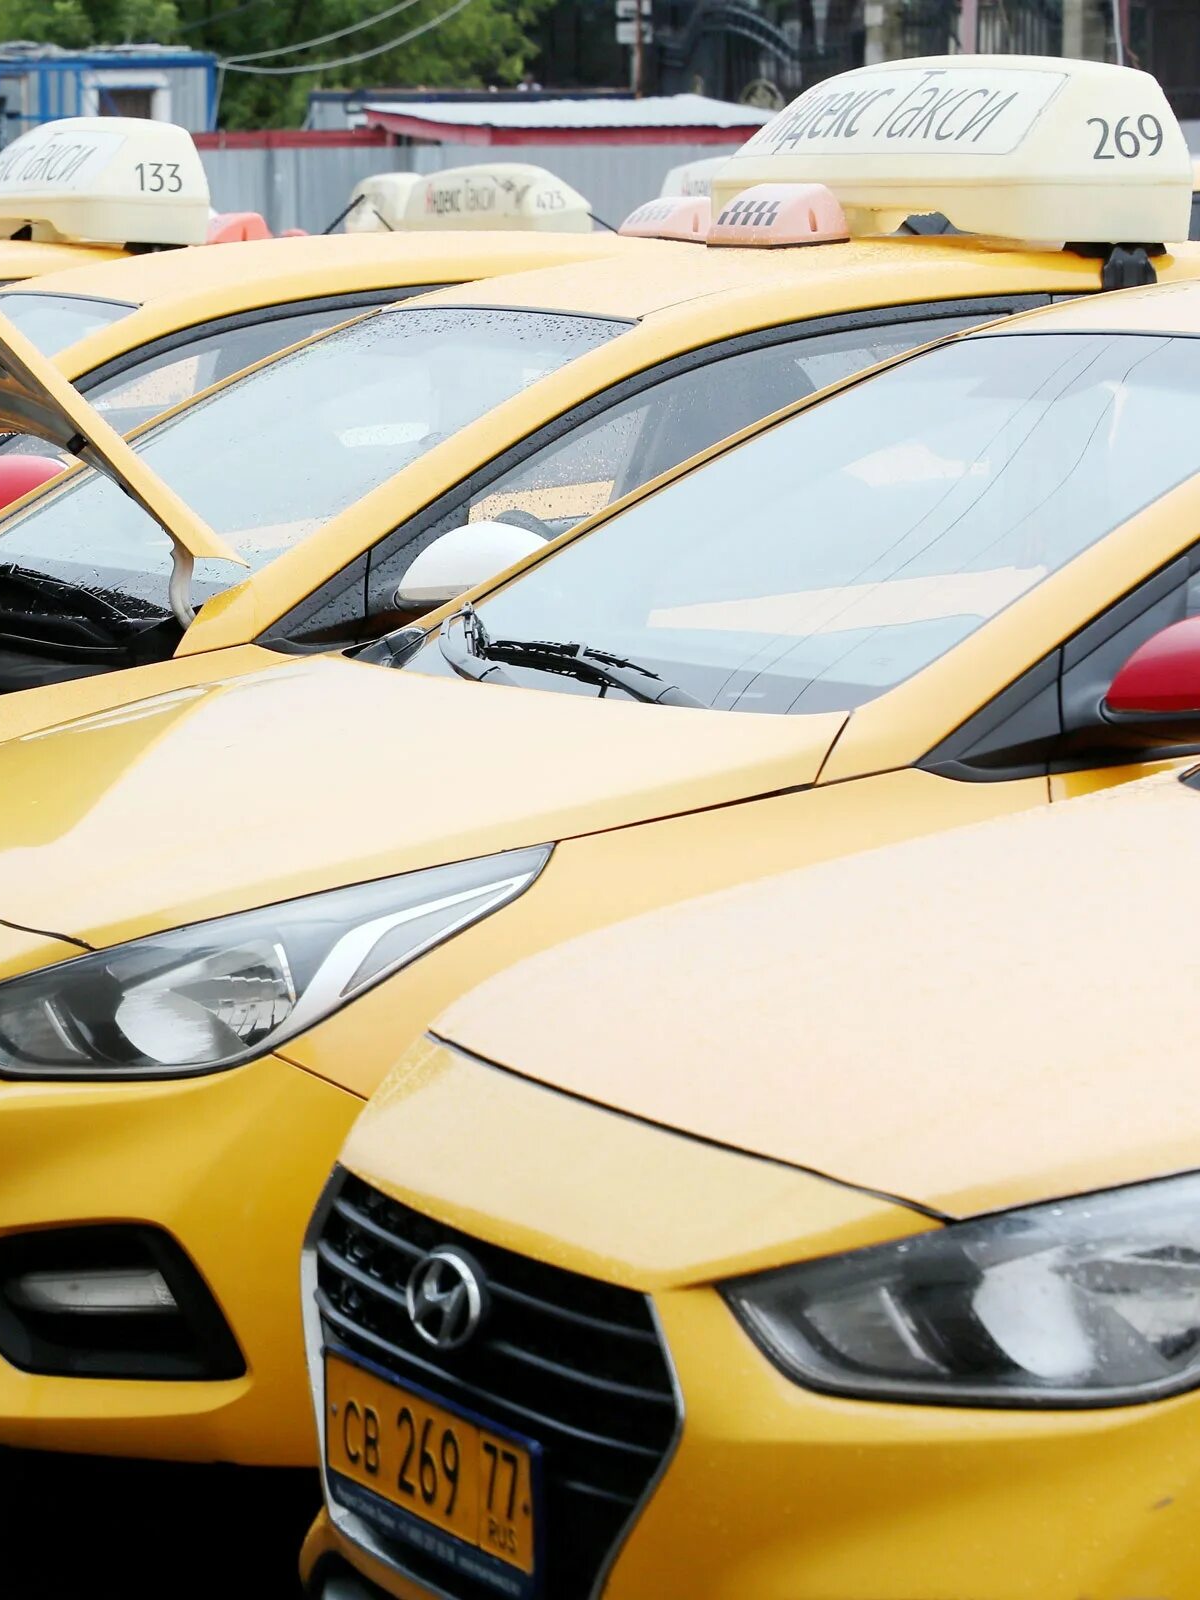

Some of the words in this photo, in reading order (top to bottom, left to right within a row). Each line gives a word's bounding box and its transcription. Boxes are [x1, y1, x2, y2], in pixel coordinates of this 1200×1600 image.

[872, 70, 1019, 142] Такси
[16, 132, 99, 181] Такси
[1086, 113, 1164, 160] 269
[134, 162, 184, 193] 133
[397, 1406, 460, 1517] 269
[482, 1440, 519, 1521] 77
[487, 1517, 518, 1555] RUS
